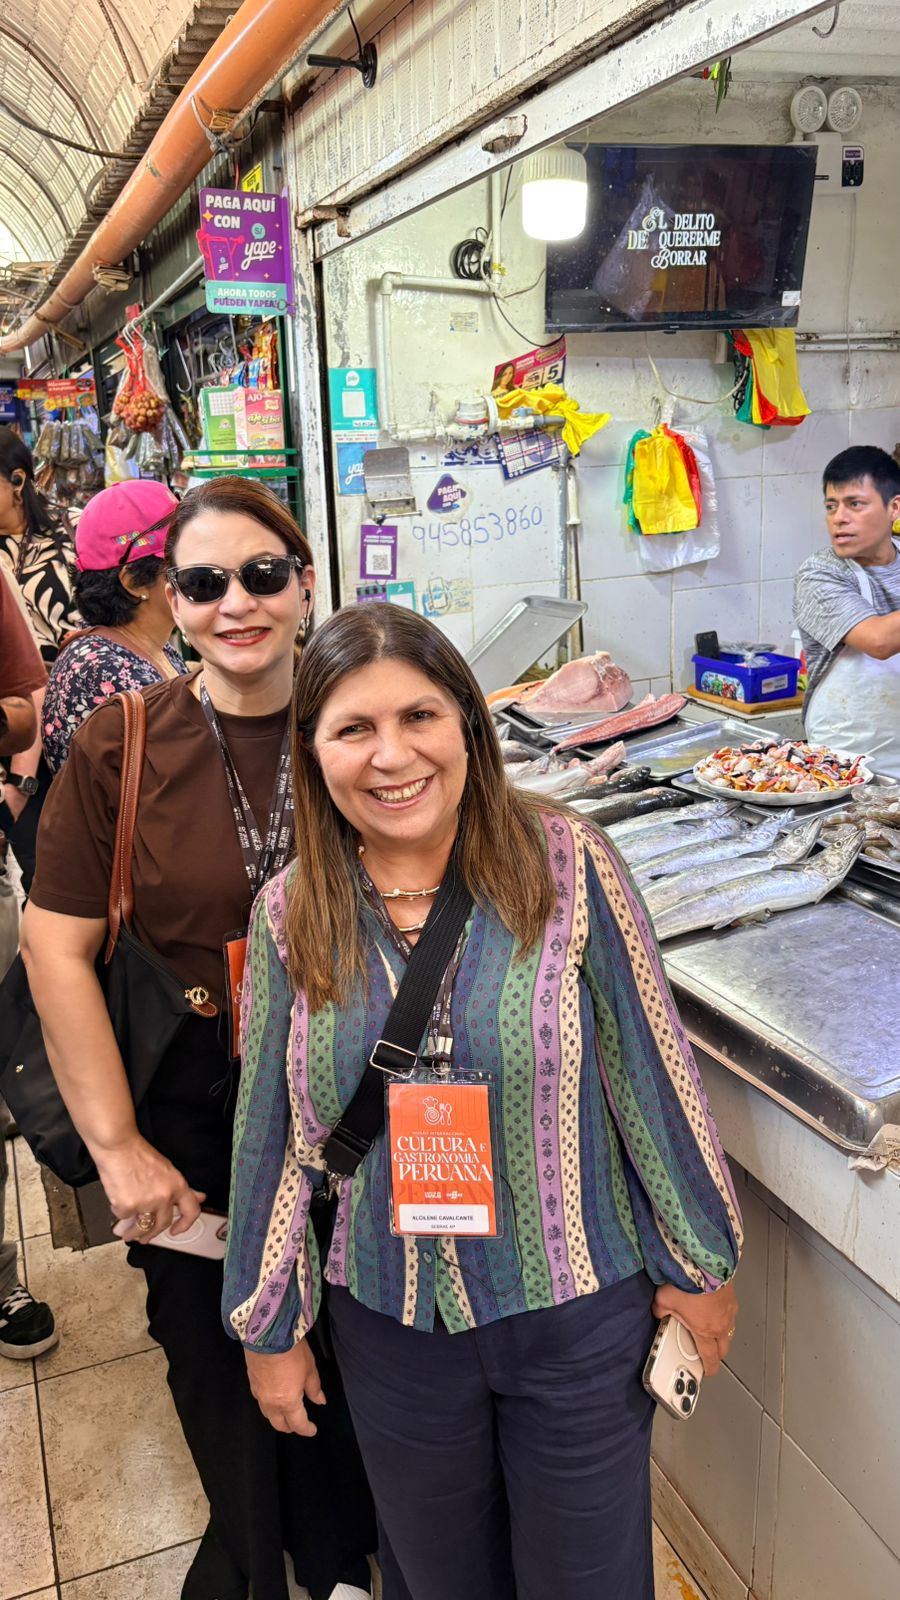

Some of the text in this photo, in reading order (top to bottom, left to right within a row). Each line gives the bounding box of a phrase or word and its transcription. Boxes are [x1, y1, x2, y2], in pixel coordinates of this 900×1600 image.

[205, 194, 276, 213] PAGA AQUÍ
[213, 214, 241, 229] CON
[641, 206, 715, 232] EL DELITO
[627, 230, 721, 250] DE QUERERME
[241, 240, 277, 271] yape
[650, 248, 707, 270] BORRAR
[217, 287, 277, 299] AHORA TODOS
[247, 392, 263, 402] AJO
[412, 505, 542, 553] 945853860
[397, 1136, 489, 1153] CULTURA E
[393, 1151, 480, 1164] GASTRONOMIA
[399, 1163, 494, 1182] PERUANA
